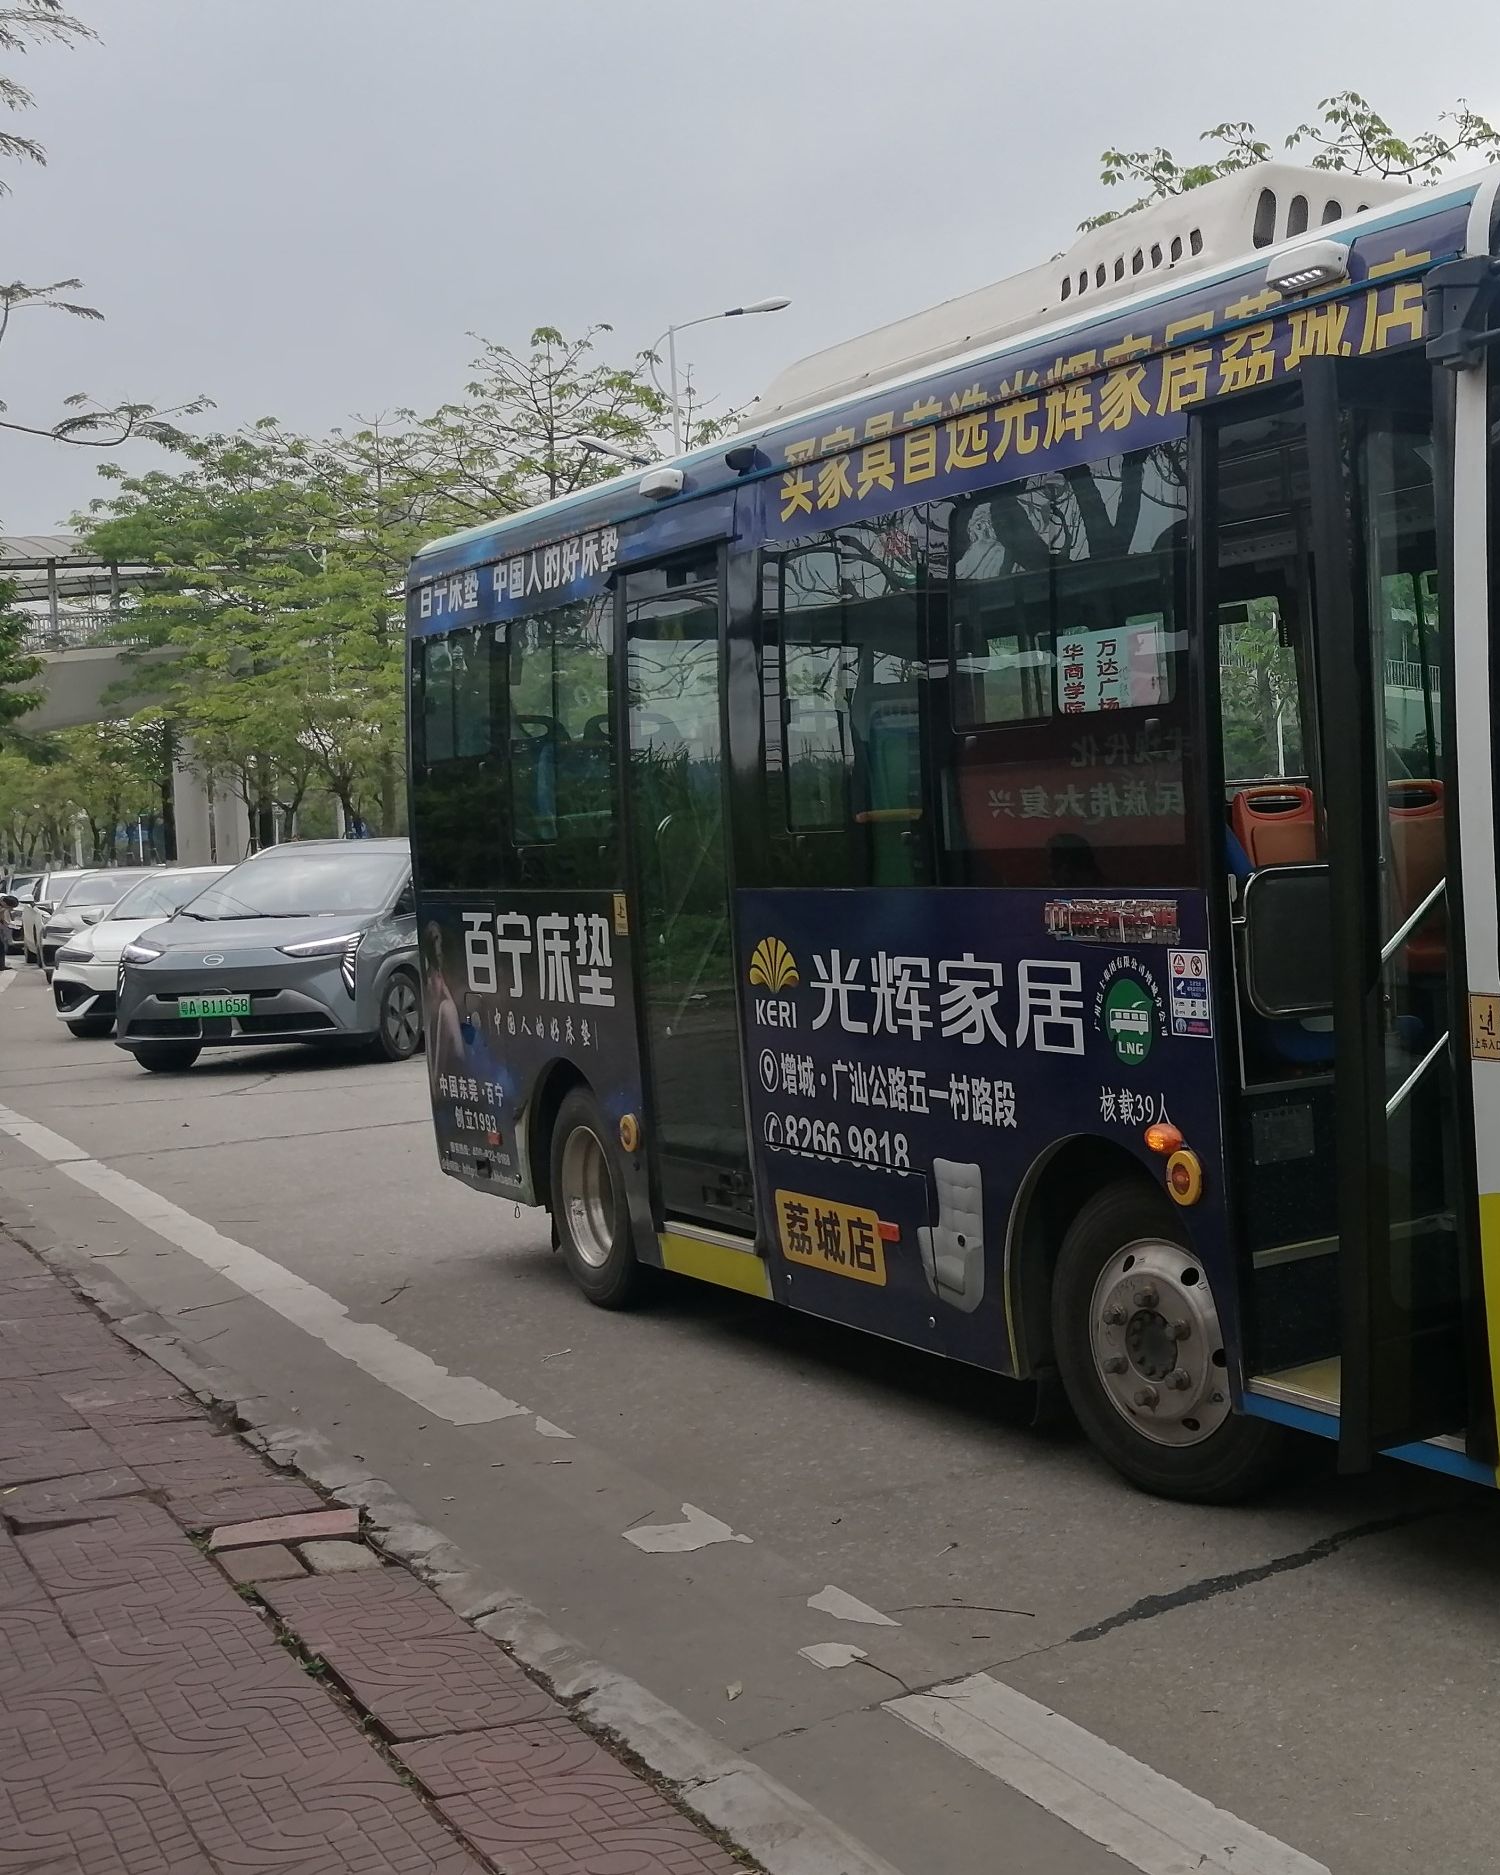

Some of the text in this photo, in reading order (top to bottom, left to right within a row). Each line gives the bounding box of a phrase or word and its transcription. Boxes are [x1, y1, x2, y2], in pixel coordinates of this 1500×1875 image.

[779, 248, 1425, 523] 买家具首选光辉家居荔城店
[493, 525, 619, 603] 中国人的好床垫
[1063, 643, 1086, 714] 华商学院
[462, 911, 615, 1008] 百宁床垫
[202, 998, 248, 1014] B11658
[494, 1007, 592, 1047] 中国人的好床垫
[755, 999, 797, 1029] KERI
[809, 948, 1085, 1056] 光辉家居
[1118, 1040, 1144, 1056] LNG
[1099, 1085, 1177, 1128] 核载39人
[785, 1114, 911, 1177] 8266 9818
[783, 1201, 877, 1273] 荔城店
